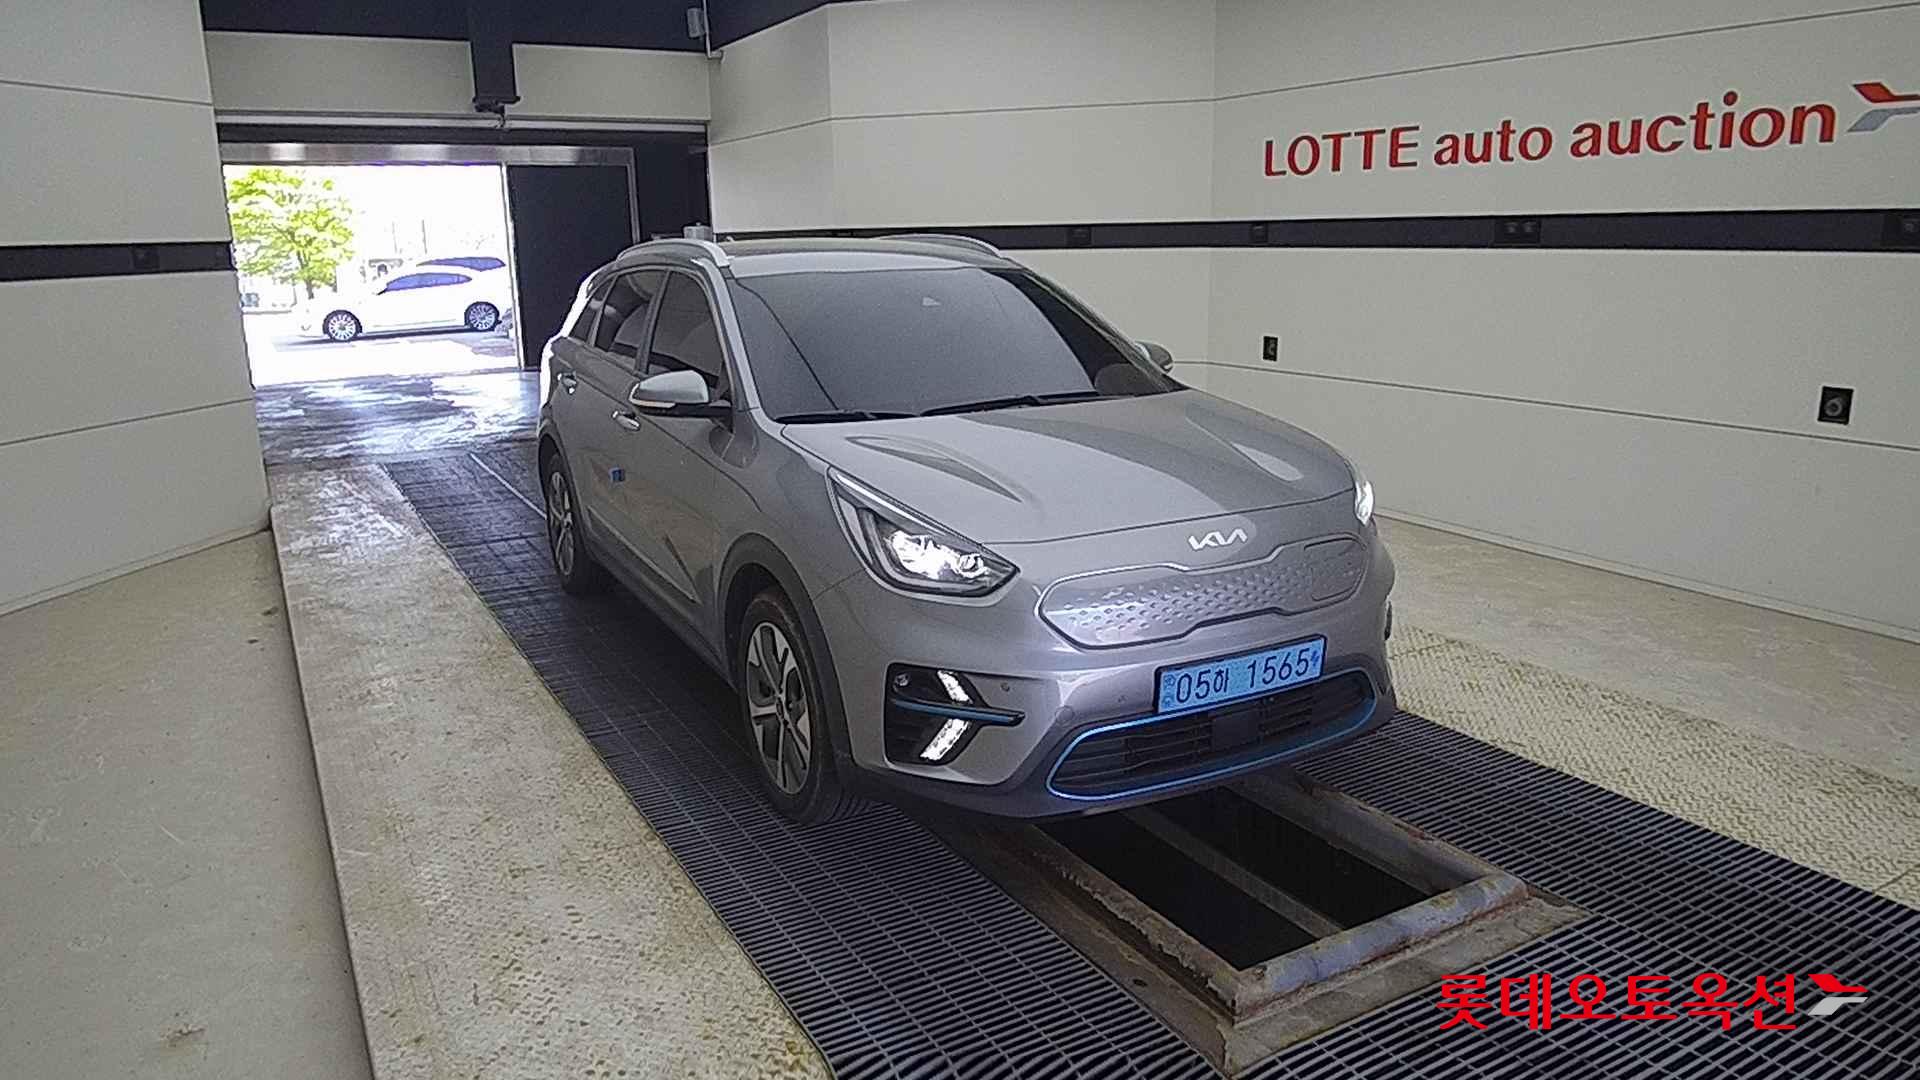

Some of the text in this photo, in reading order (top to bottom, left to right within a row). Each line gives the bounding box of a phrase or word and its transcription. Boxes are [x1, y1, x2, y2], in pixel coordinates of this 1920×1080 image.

[1264, 90, 1835, 177] LOTTE auto auction
[1176, 648, 1310, 703] 05하 1565
